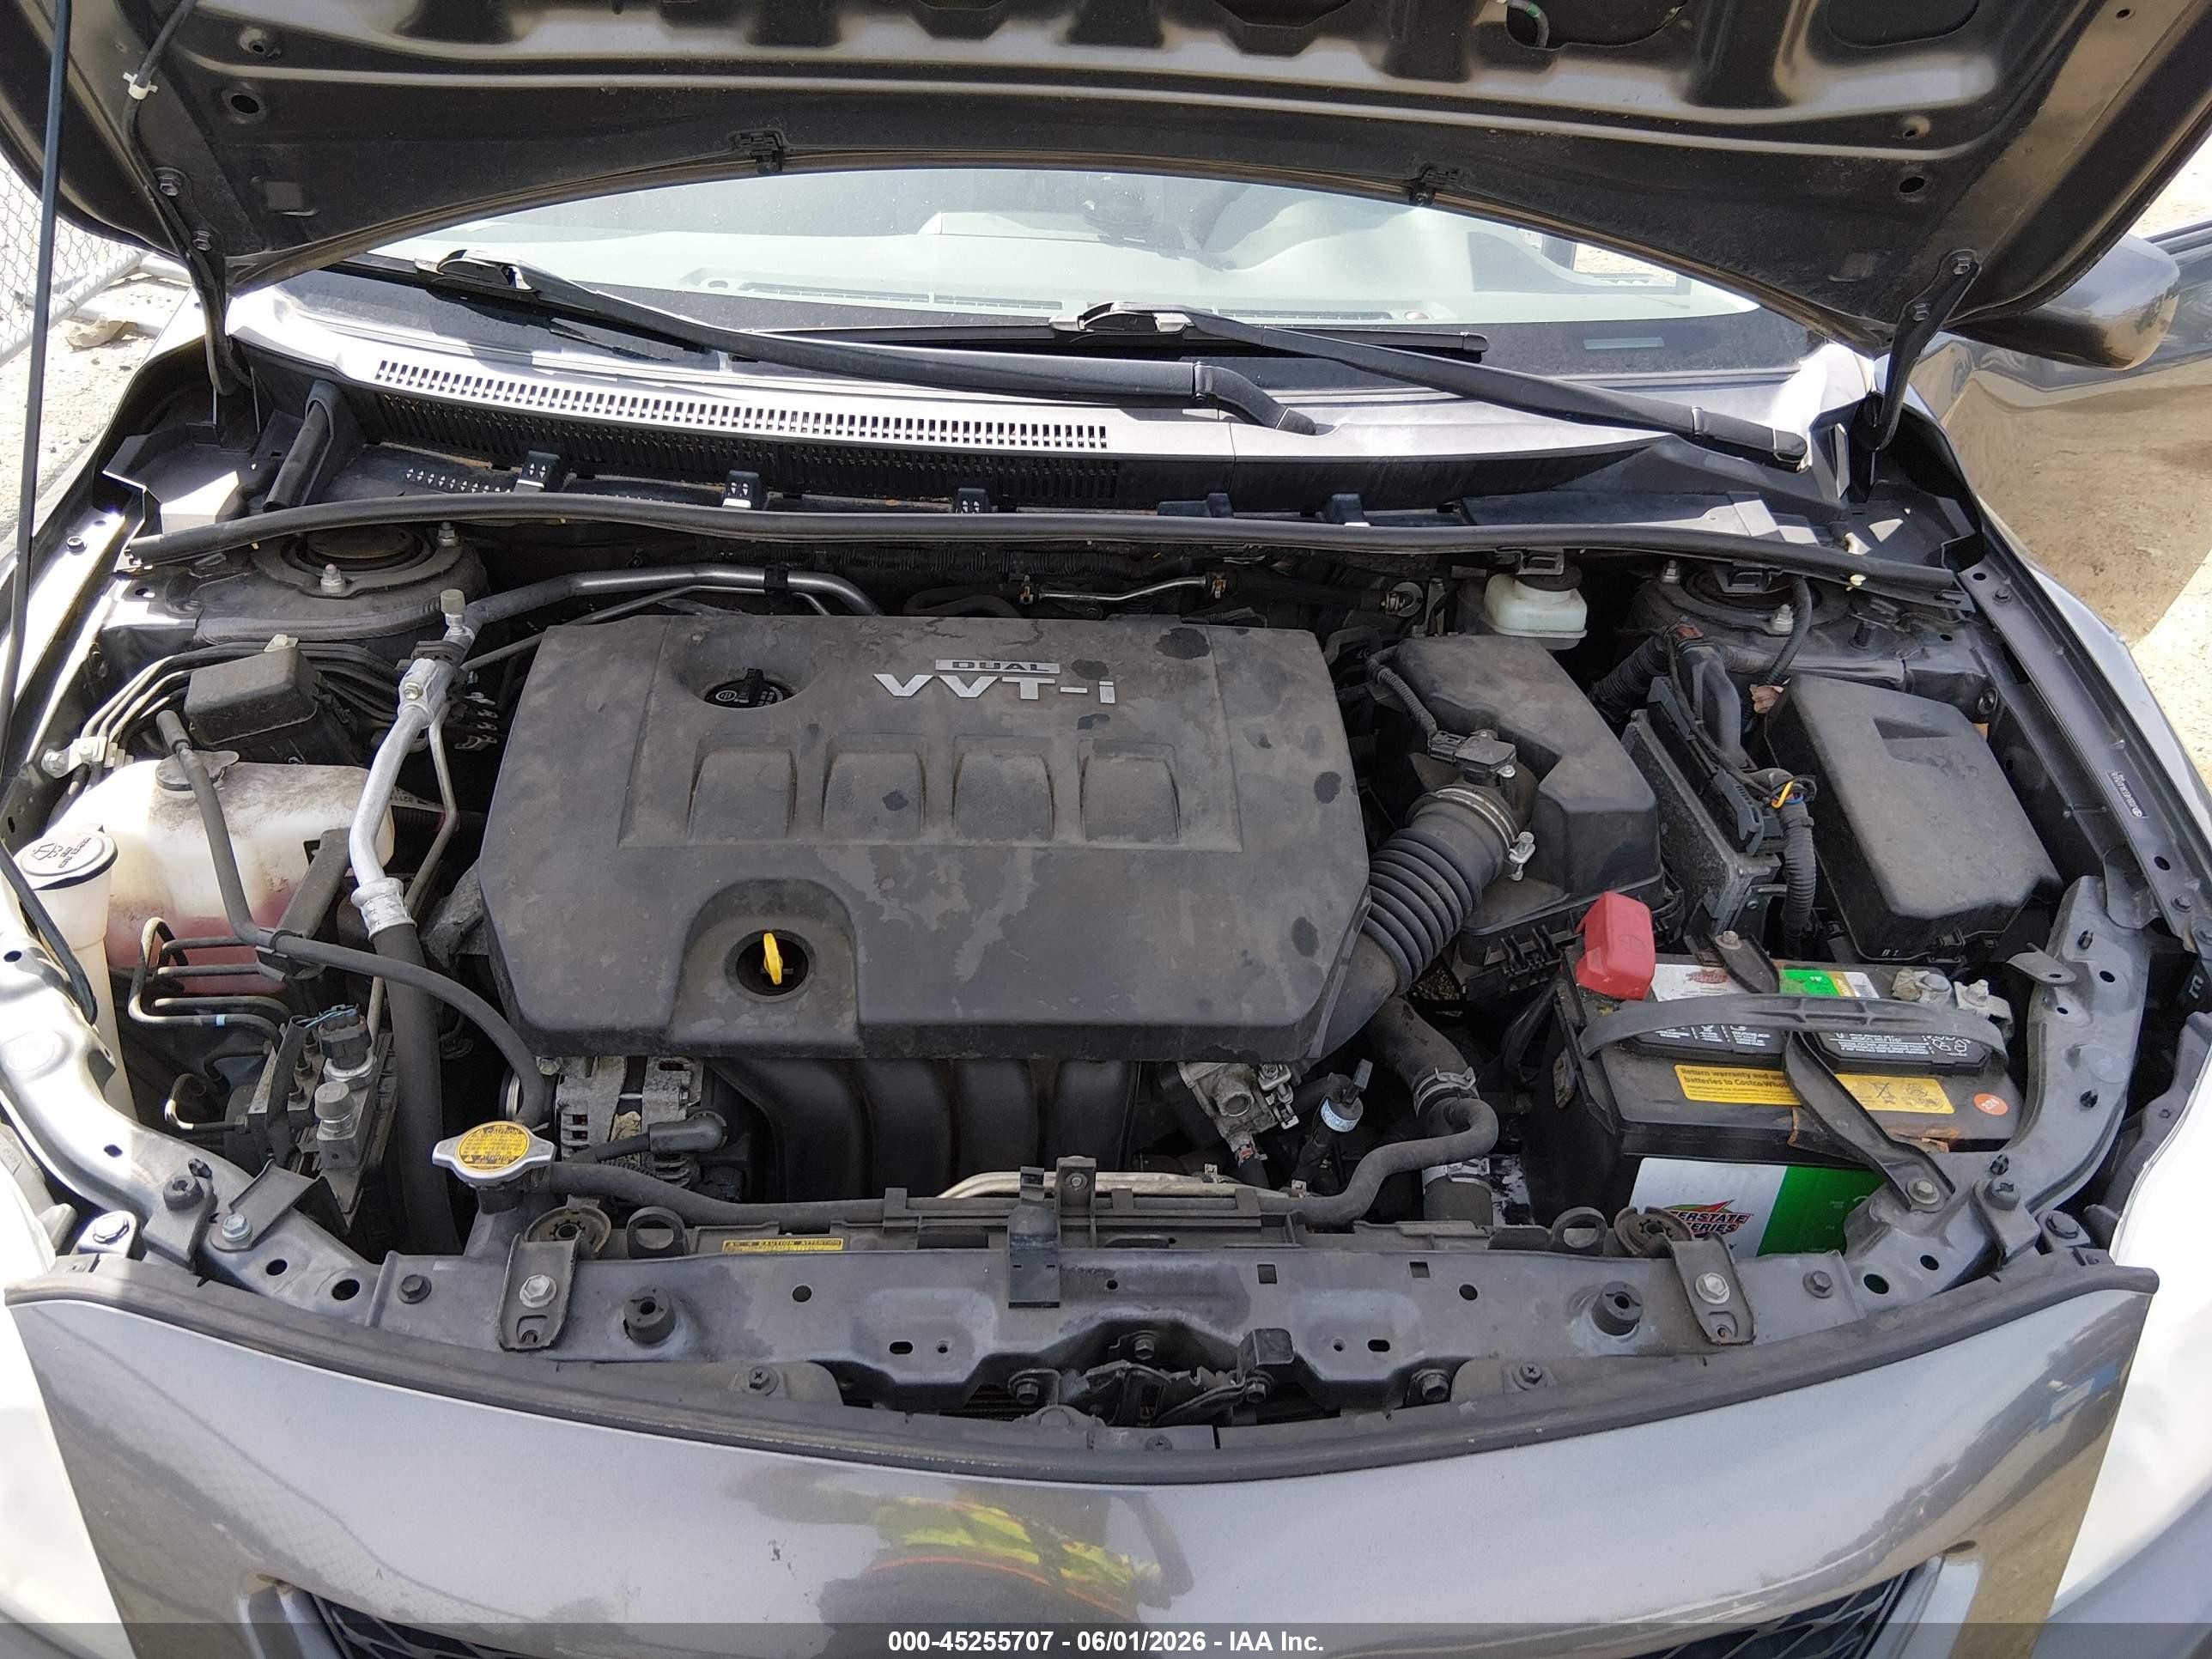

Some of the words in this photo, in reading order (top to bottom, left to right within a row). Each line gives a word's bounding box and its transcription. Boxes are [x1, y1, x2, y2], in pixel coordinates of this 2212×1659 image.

[952, 660, 1050, 672] DUAL
[872, 673, 1115, 704] VVT-i
[1680, 1067, 1711, 1076] Return
[1712, 1071, 1751, 1079] warranty
[1684, 1075, 1723, 1085] batteries
[1672, 1211, 1746, 1224] ERSTATE
[1687, 1222, 1737, 1233] ERIES
